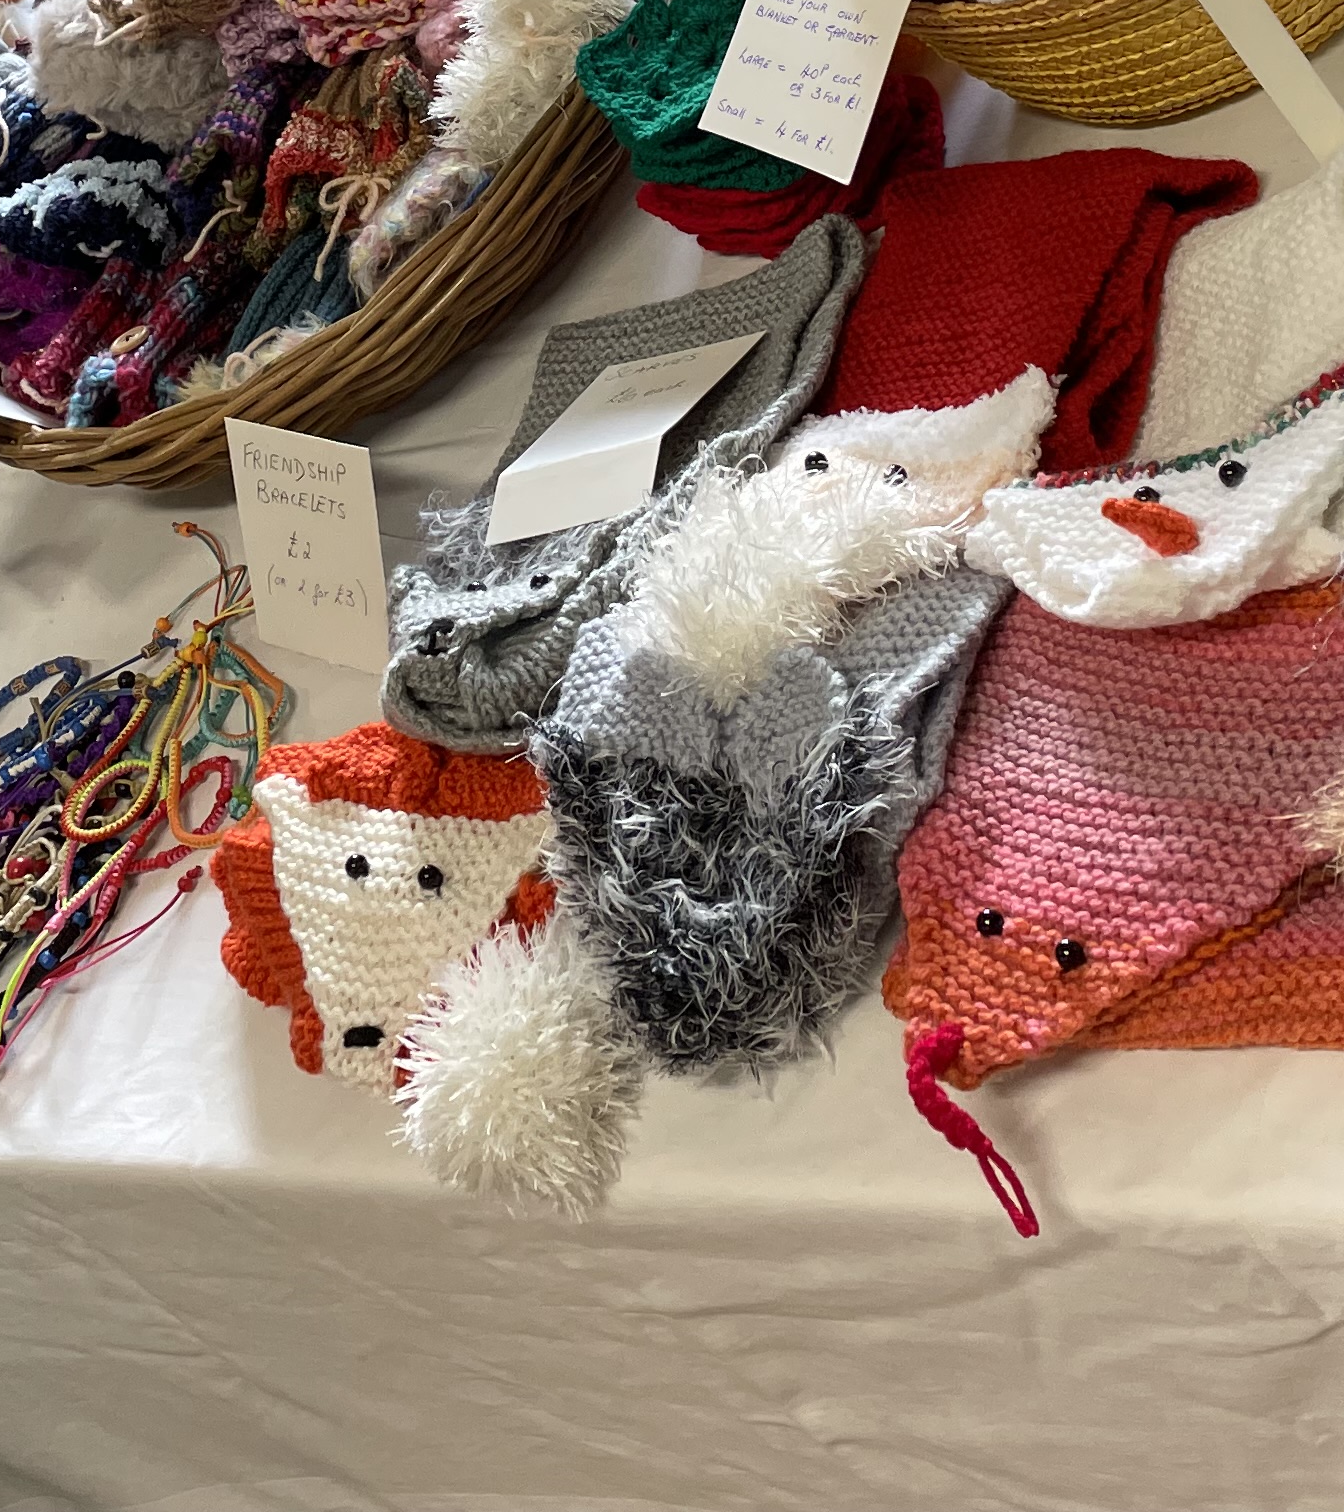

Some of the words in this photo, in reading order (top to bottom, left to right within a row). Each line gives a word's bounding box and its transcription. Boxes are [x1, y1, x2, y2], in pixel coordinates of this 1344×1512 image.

[804, 20, 819, 33] OR
[838, 9, 867, 24] OWN
[789, 83, 803, 94] OR
[833, 73, 862, 87] each
[718, 99, 746, 119] Small
[775, 121, 786, 136] 4
[243, 442, 346, 484] FRIENDSHIP
[257, 480, 346, 519] BRACELETS
[288, 531, 312, 559] £2
